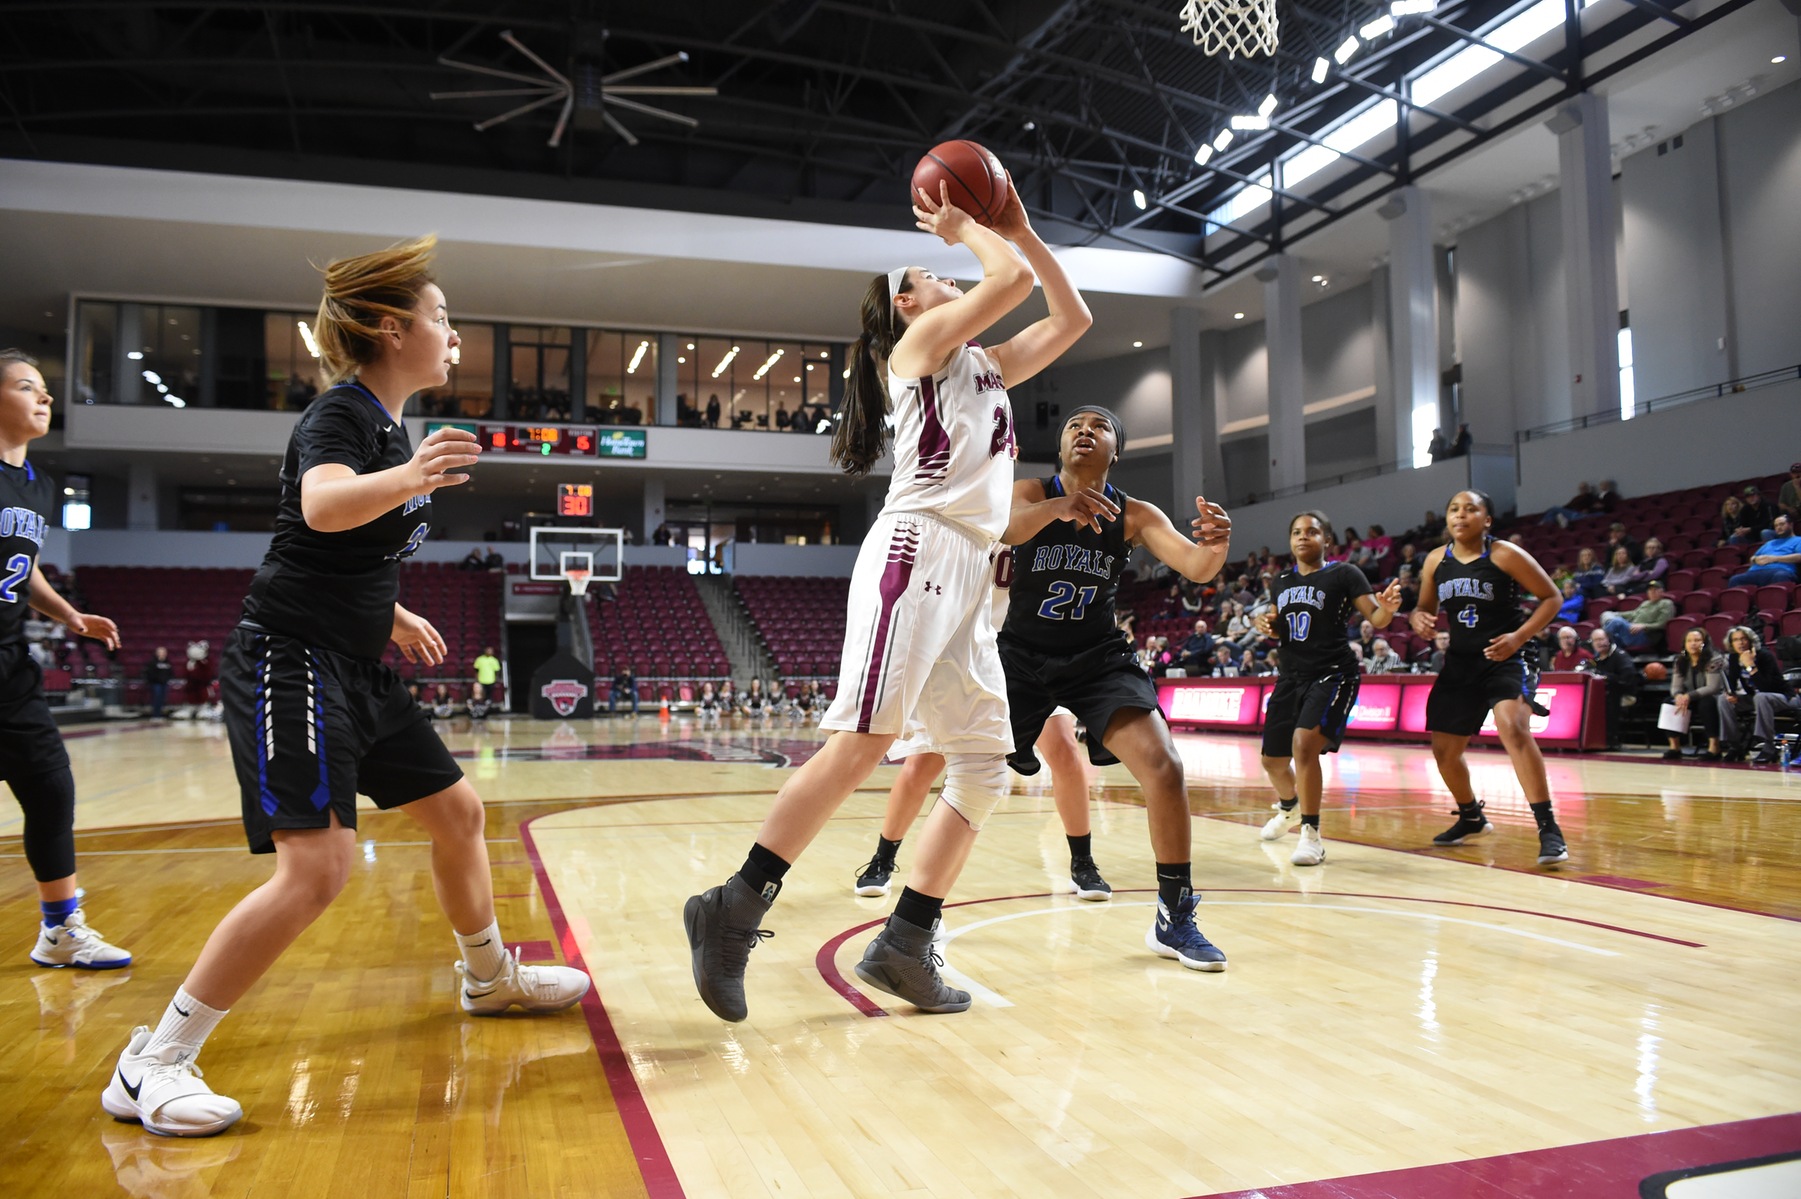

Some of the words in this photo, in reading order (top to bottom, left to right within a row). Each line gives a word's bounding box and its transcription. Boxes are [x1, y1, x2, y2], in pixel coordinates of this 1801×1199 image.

[541, 443, 551, 455] 2
[563, 496, 587, 516] 30
[1032, 544, 1115, 580] ROYALS
[1037, 580, 1098, 620] 21
[1438, 578, 1495, 603] ROYALS
[1286, 611, 1312, 641] 10
[1457, 604, 1480, 628] 4
